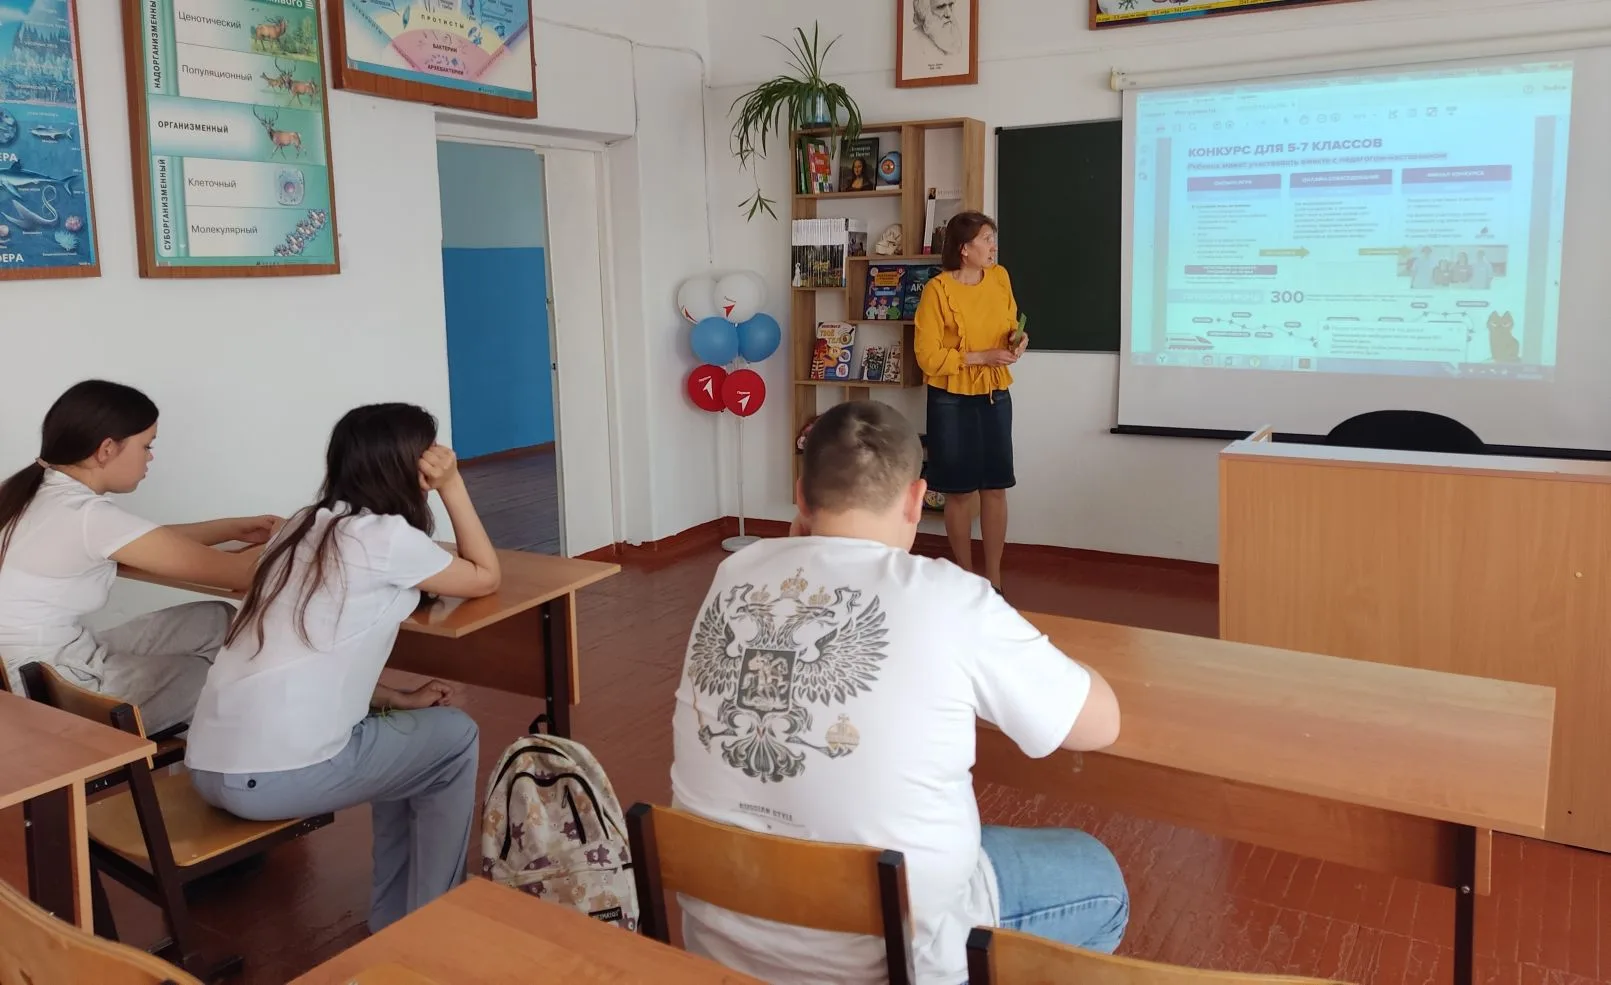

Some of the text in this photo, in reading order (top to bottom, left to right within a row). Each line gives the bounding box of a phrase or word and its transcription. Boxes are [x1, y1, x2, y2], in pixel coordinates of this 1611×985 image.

[178, 11, 241, 29] Ценотический
[421, 14, 464, 29] ПРОТИСТЫ
[150, 0, 161, 88] НАДОРГАНИЗМЕННЫ
[432, 43, 458, 53] БАКТЕРИИ
[181, 64, 252, 81] Популяционный
[157, 120, 229, 133] ОРГАНИЗМЕННЫЙ
[1188, 138, 1383, 157] КОНКУРС ДЛЯ 5-7 КЛАССОВ
[188, 178, 236, 188] Клеточный
[158, 159, 171, 250] СУБОРГАНИЗМЕННЫЙ
[191, 225, 258, 235] Молекулярный
[0, 253, 24, 262] ЕРА
[1270, 290, 1304, 303] 300
